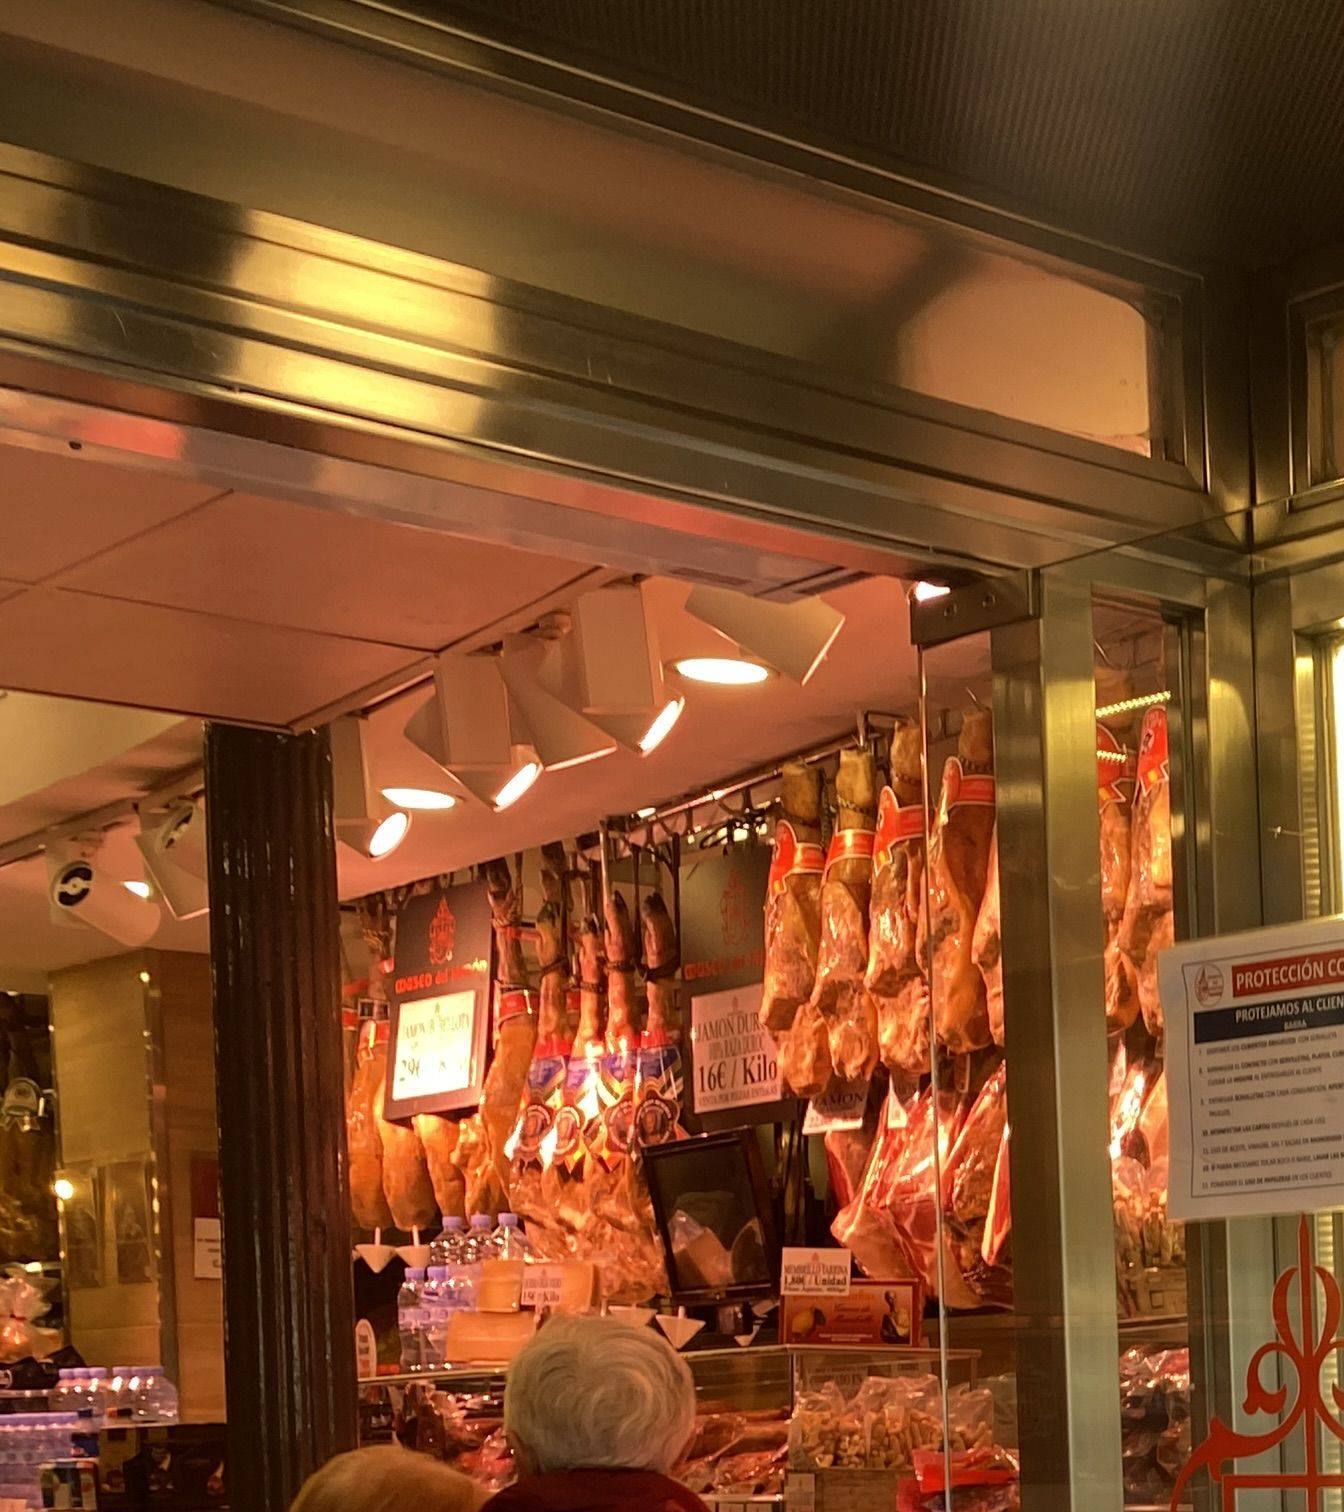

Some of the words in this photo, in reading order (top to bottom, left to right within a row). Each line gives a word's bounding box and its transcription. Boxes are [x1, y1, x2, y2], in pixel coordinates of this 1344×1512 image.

[1236, 959, 1324, 990] PROTECCIÓN
[1235, 1001, 1300, 1023] PROTEJAMOS
[1302, 1000, 1314, 1013] AL
[700, 1058, 728, 1093] 16€
[731, 1058, 738, 1088] /
[742, 1053, 778, 1086] Kilo
[815, 1275, 847, 1287] Unidad
